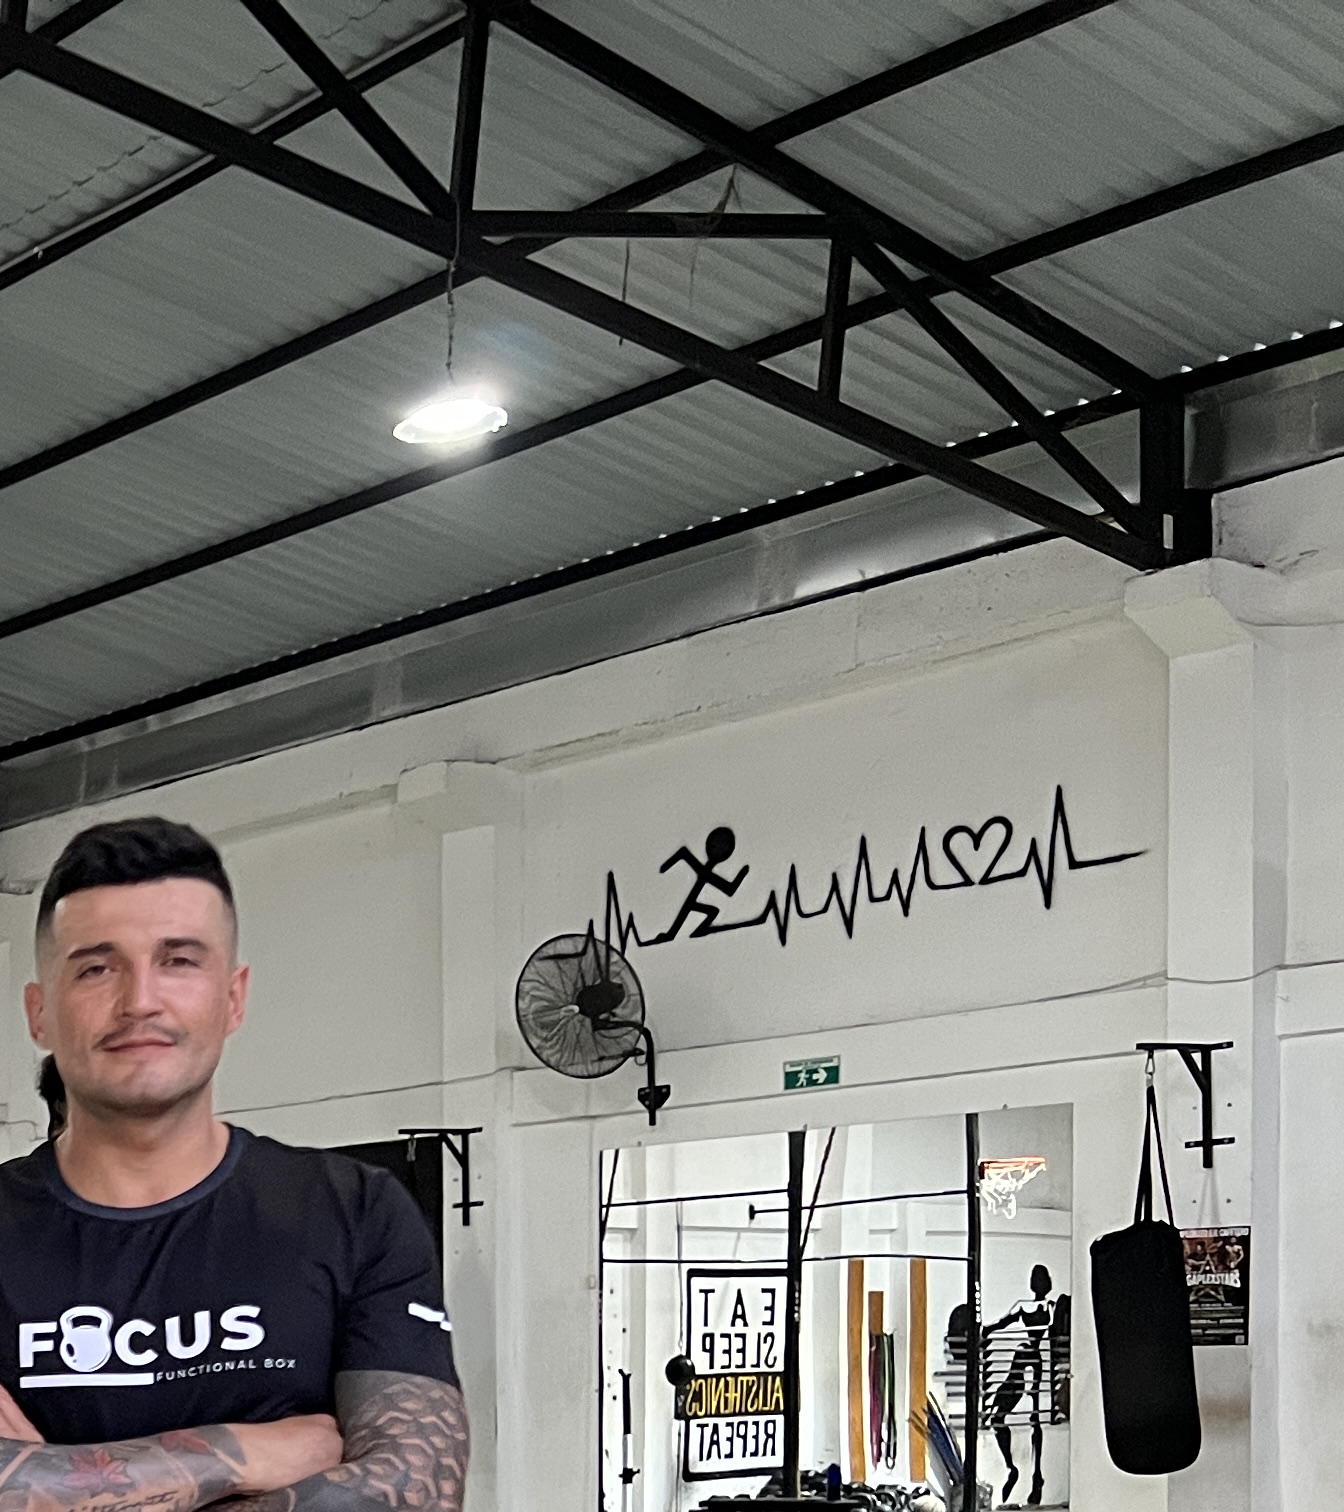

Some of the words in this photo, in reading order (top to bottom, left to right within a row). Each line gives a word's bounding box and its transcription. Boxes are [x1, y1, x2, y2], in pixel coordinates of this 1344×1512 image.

[18, 1304, 266, 1373] FOCUS
[156, 1359, 256, 1382] FUNCTIONAL
[263, 1358, 297, 1369] BOX
